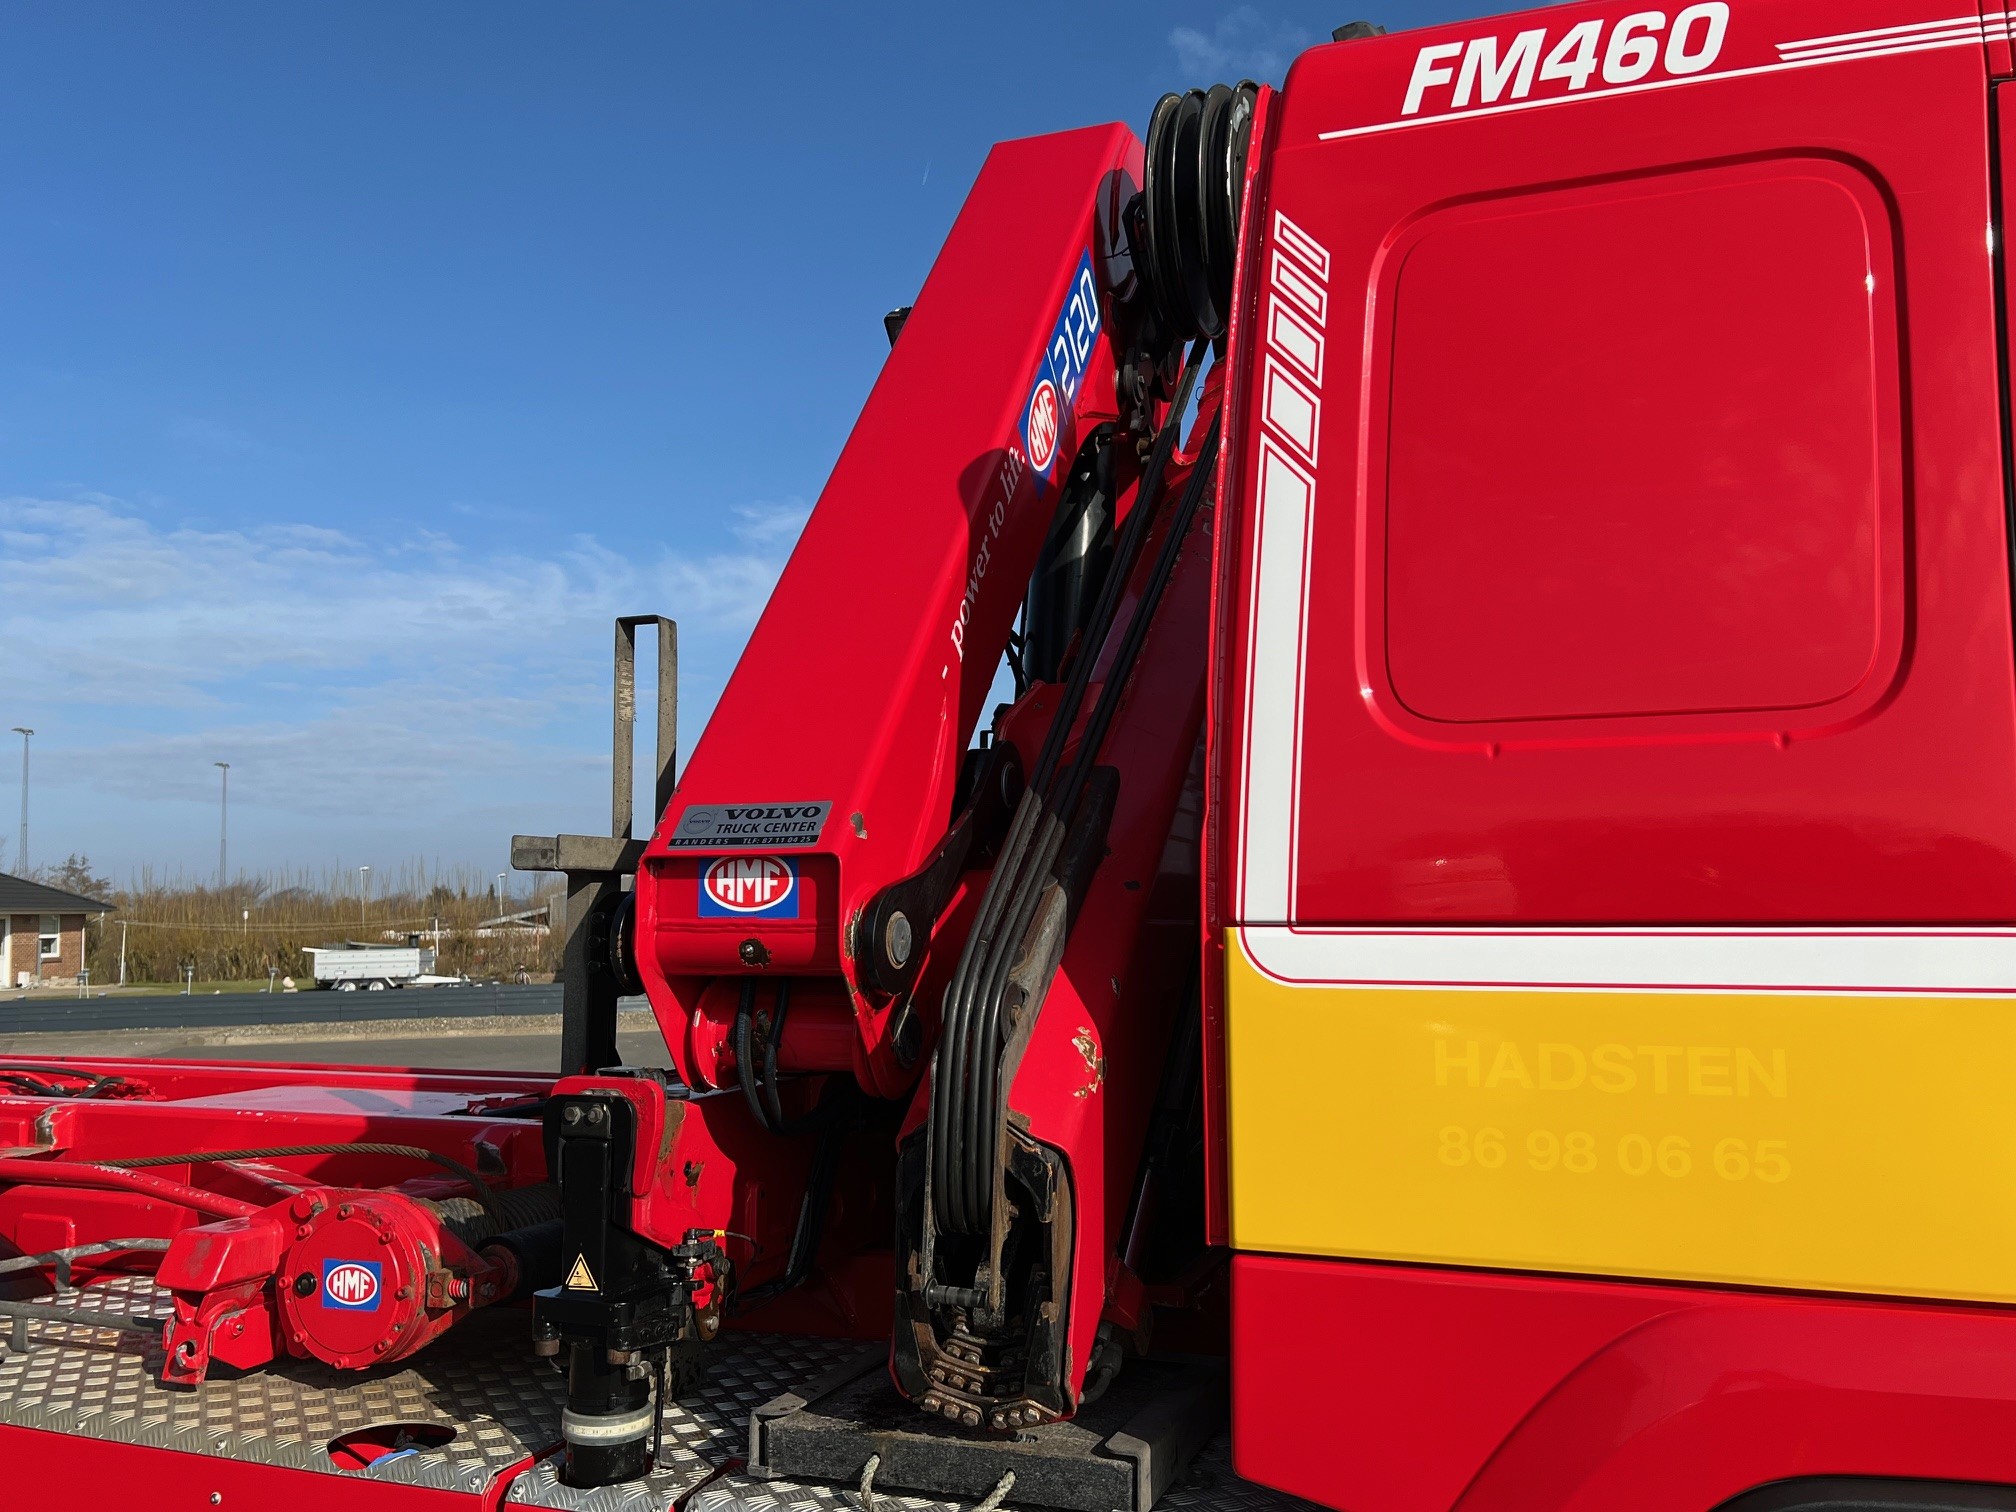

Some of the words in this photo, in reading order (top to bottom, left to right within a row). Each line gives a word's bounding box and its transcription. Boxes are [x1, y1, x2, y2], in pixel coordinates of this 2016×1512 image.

[1401, 1, 1729, 116] FM460
[1030, 389, 1056, 460] HMF
[1053, 267, 1099, 405] 2120
[950, 537, 992, 663] power
[988, 500, 1005, 539] to
[1000, 446, 1026, 505] lift.
[716, 823, 759, 834] TRUCK
[763, 821, 817, 833] CENTER
[724, 806, 822, 820] VOLVO
[675, 838, 729, 846] RANDERS
[716, 858, 780, 903] HMF
[1434, 1039, 1788, 1099] HADSTEN
[1437, 1125, 1508, 1169] 86
[1526, 1129, 1599, 1174] 98
[1617, 1133, 1693, 1179] 06
[1713, 1137, 1792, 1184] 65
[332, 1269, 371, 1300] HMF
